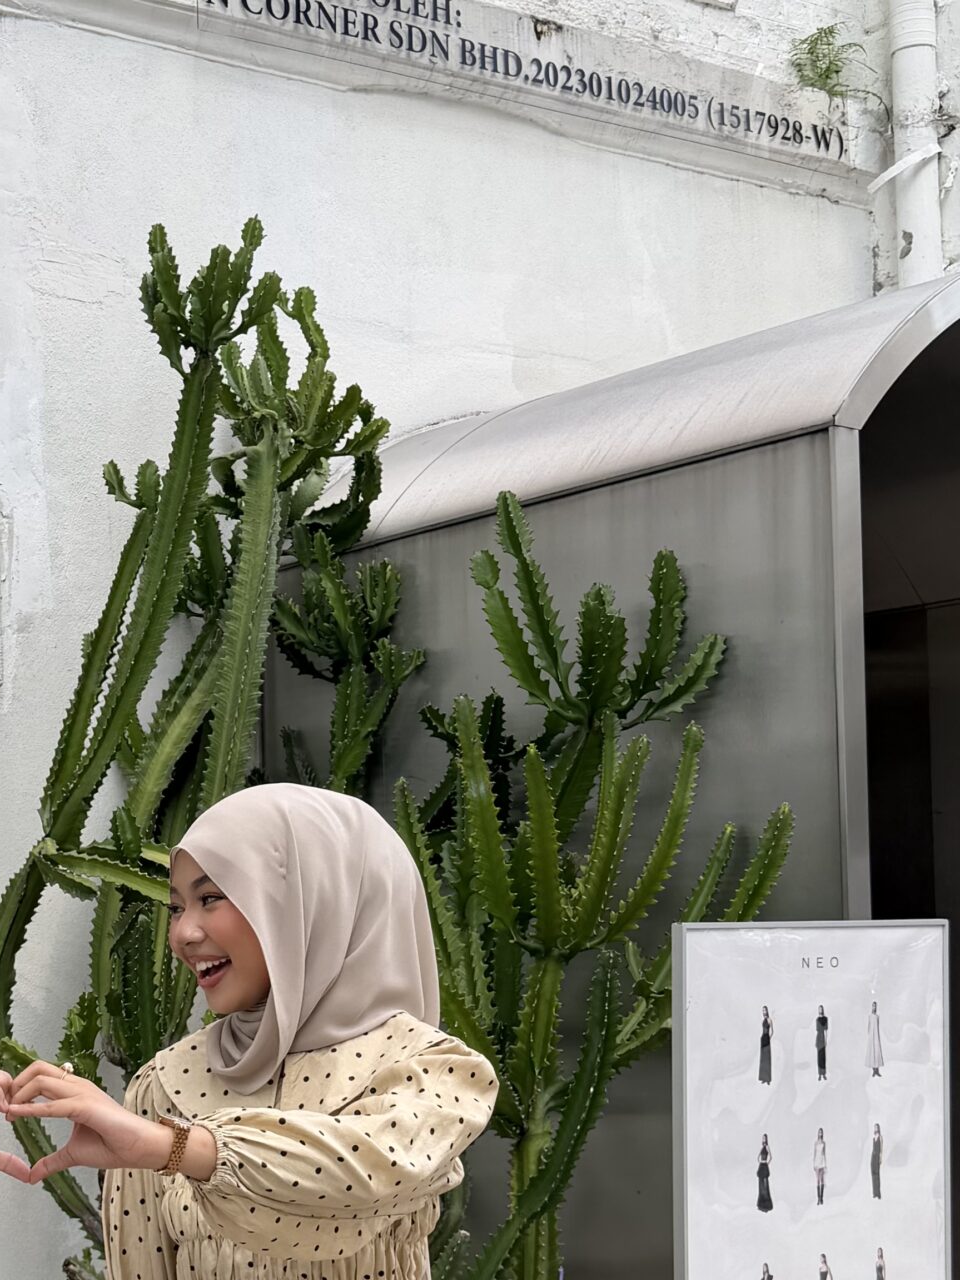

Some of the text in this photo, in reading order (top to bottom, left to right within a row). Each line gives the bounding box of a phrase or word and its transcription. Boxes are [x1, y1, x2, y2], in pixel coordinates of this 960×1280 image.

[371, 0, 462, 28] EH:
[390, 20, 451, 61] SDN
[801, 956, 839, 969] NEO
